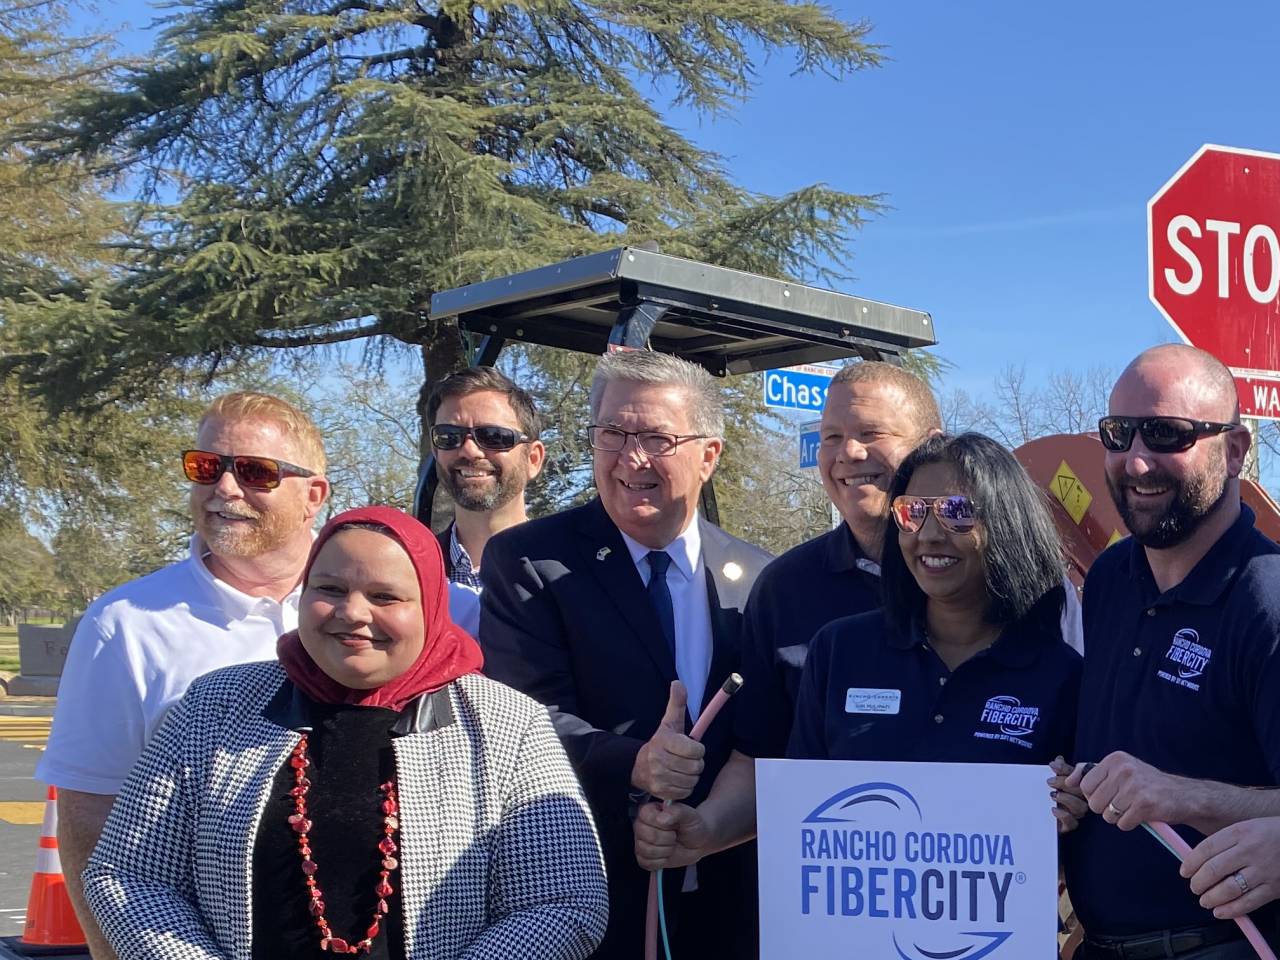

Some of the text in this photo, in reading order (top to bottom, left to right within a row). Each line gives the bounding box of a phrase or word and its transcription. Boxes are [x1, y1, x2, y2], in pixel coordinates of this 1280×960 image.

[1165, 645, 1208, 672] FIBERCITY
[985, 701, 1011, 712] RANCHO
[980, 709, 1037, 729] FIBERCITY
[801, 828, 1015, 866] RANCHO CORDOVA
